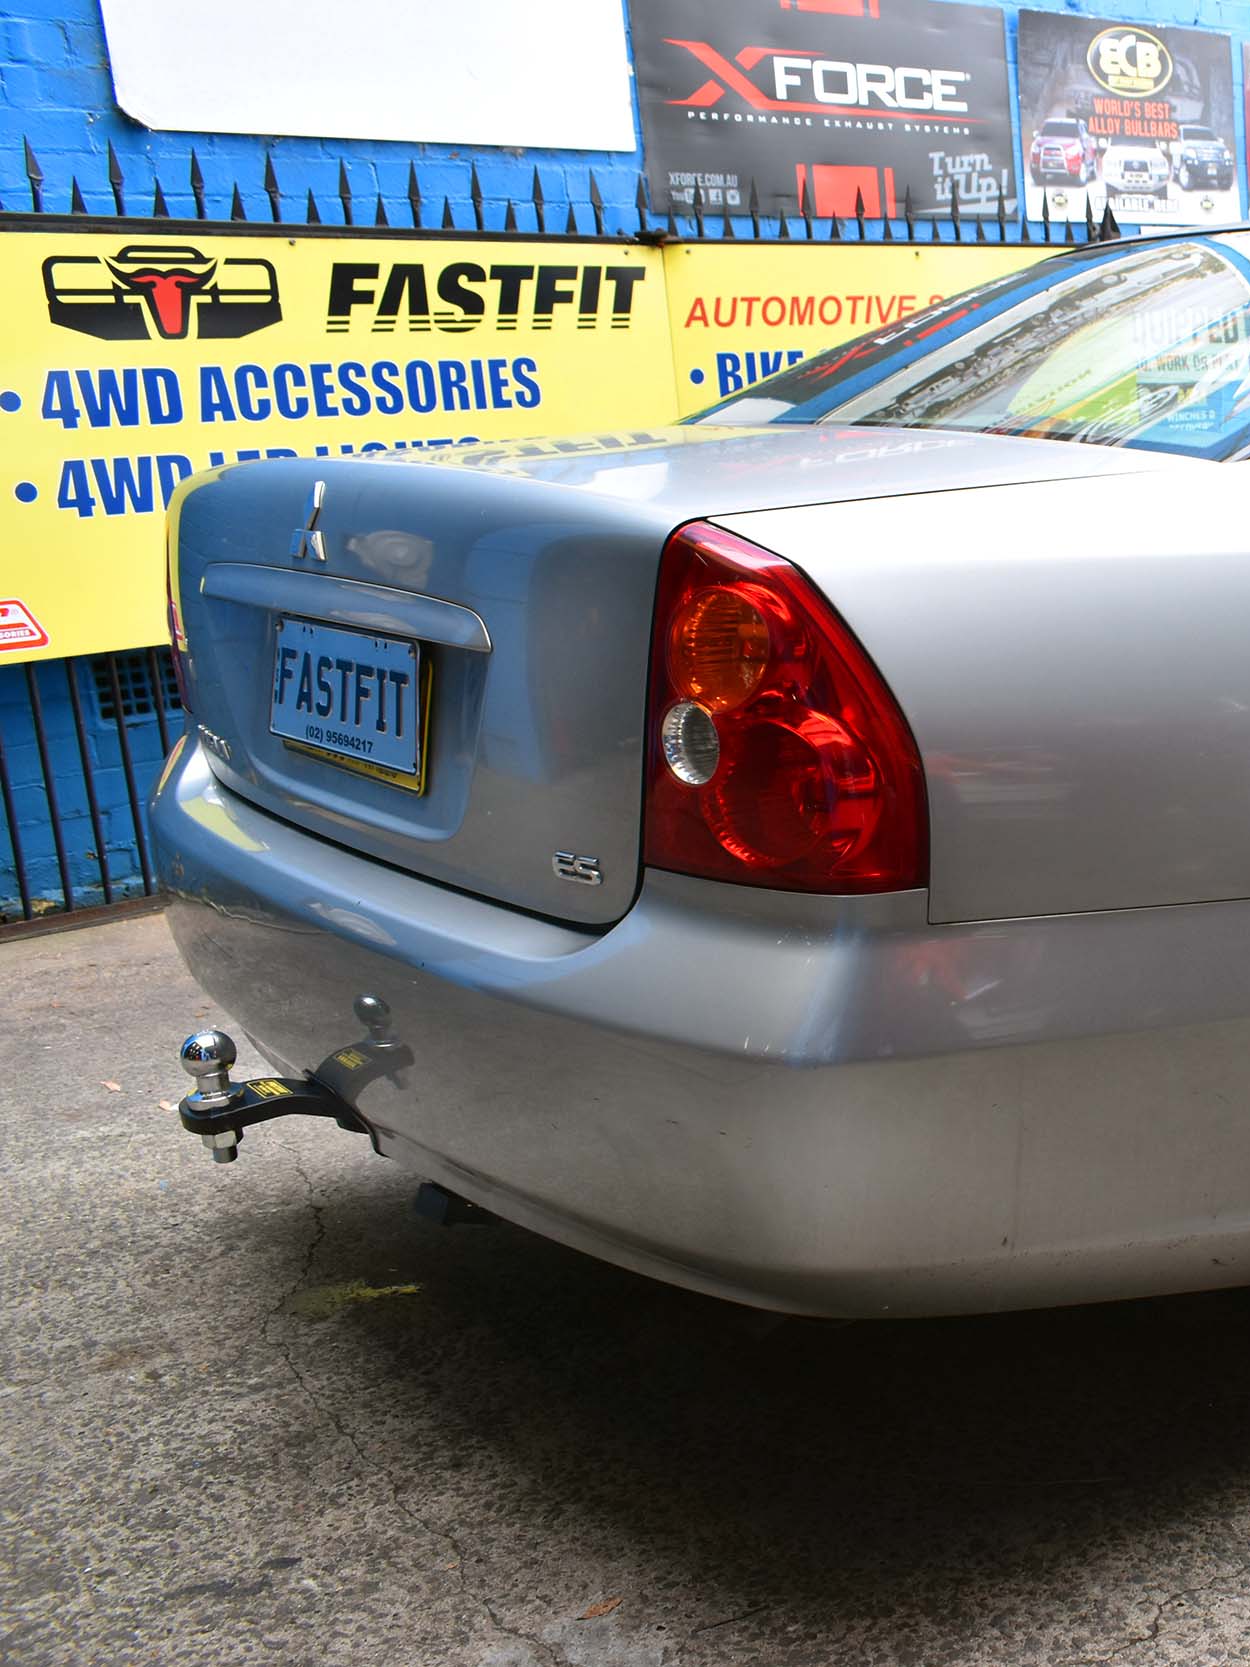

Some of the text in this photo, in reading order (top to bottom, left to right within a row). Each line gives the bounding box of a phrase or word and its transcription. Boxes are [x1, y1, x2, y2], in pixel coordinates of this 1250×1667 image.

[1099, 34, 1162, 78] ECB
[687, 111, 970, 136] PERFORMANCE EXHAUST SYSTEMS
[1093, 98, 1171, 120] WORLD'S BEST
[1088, 116, 1178, 139] ALLOY BULLBARS
[928, 151, 993, 176] Turn
[326, 261, 647, 334] FASTFIT
[684, 294, 917, 328] AUTOMOTIVE
[42, 357, 541, 429] 4WD ACCESSORIES
[277, 646, 410, 739] FASTFIT
[305, 724, 374, 754] (02) 95694217
